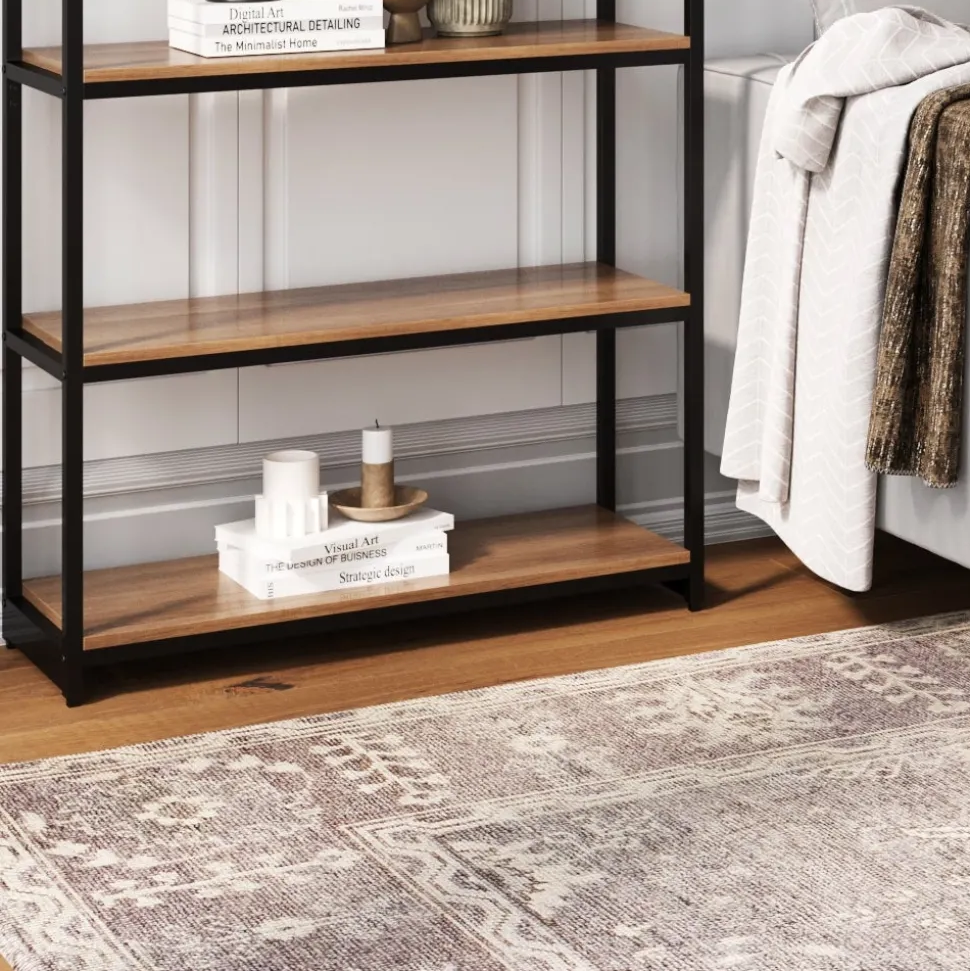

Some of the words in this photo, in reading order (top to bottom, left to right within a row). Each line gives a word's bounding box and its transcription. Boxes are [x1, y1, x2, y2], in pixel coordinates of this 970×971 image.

[229, 6, 265, 24] Digital
[267, 6, 284, 19] Art
[222, 20, 306, 35] ARCHITECTURAL
[308, 17, 361, 31] DETAILING
[215, 41, 233, 52] The
[236, 38, 286, 51] Minimalist
[289, 38, 318, 48] Home
[323, 537, 358, 554] Visual
[361, 535, 379, 546] Art
[265, 561, 285, 572] THE
[287, 557, 323, 570] DESIGN
[325, 554, 339, 565] OF
[340, 548, 387, 563] BUISNESS
[339, 567, 382, 584] Strategic
[384, 563, 416, 578] design
